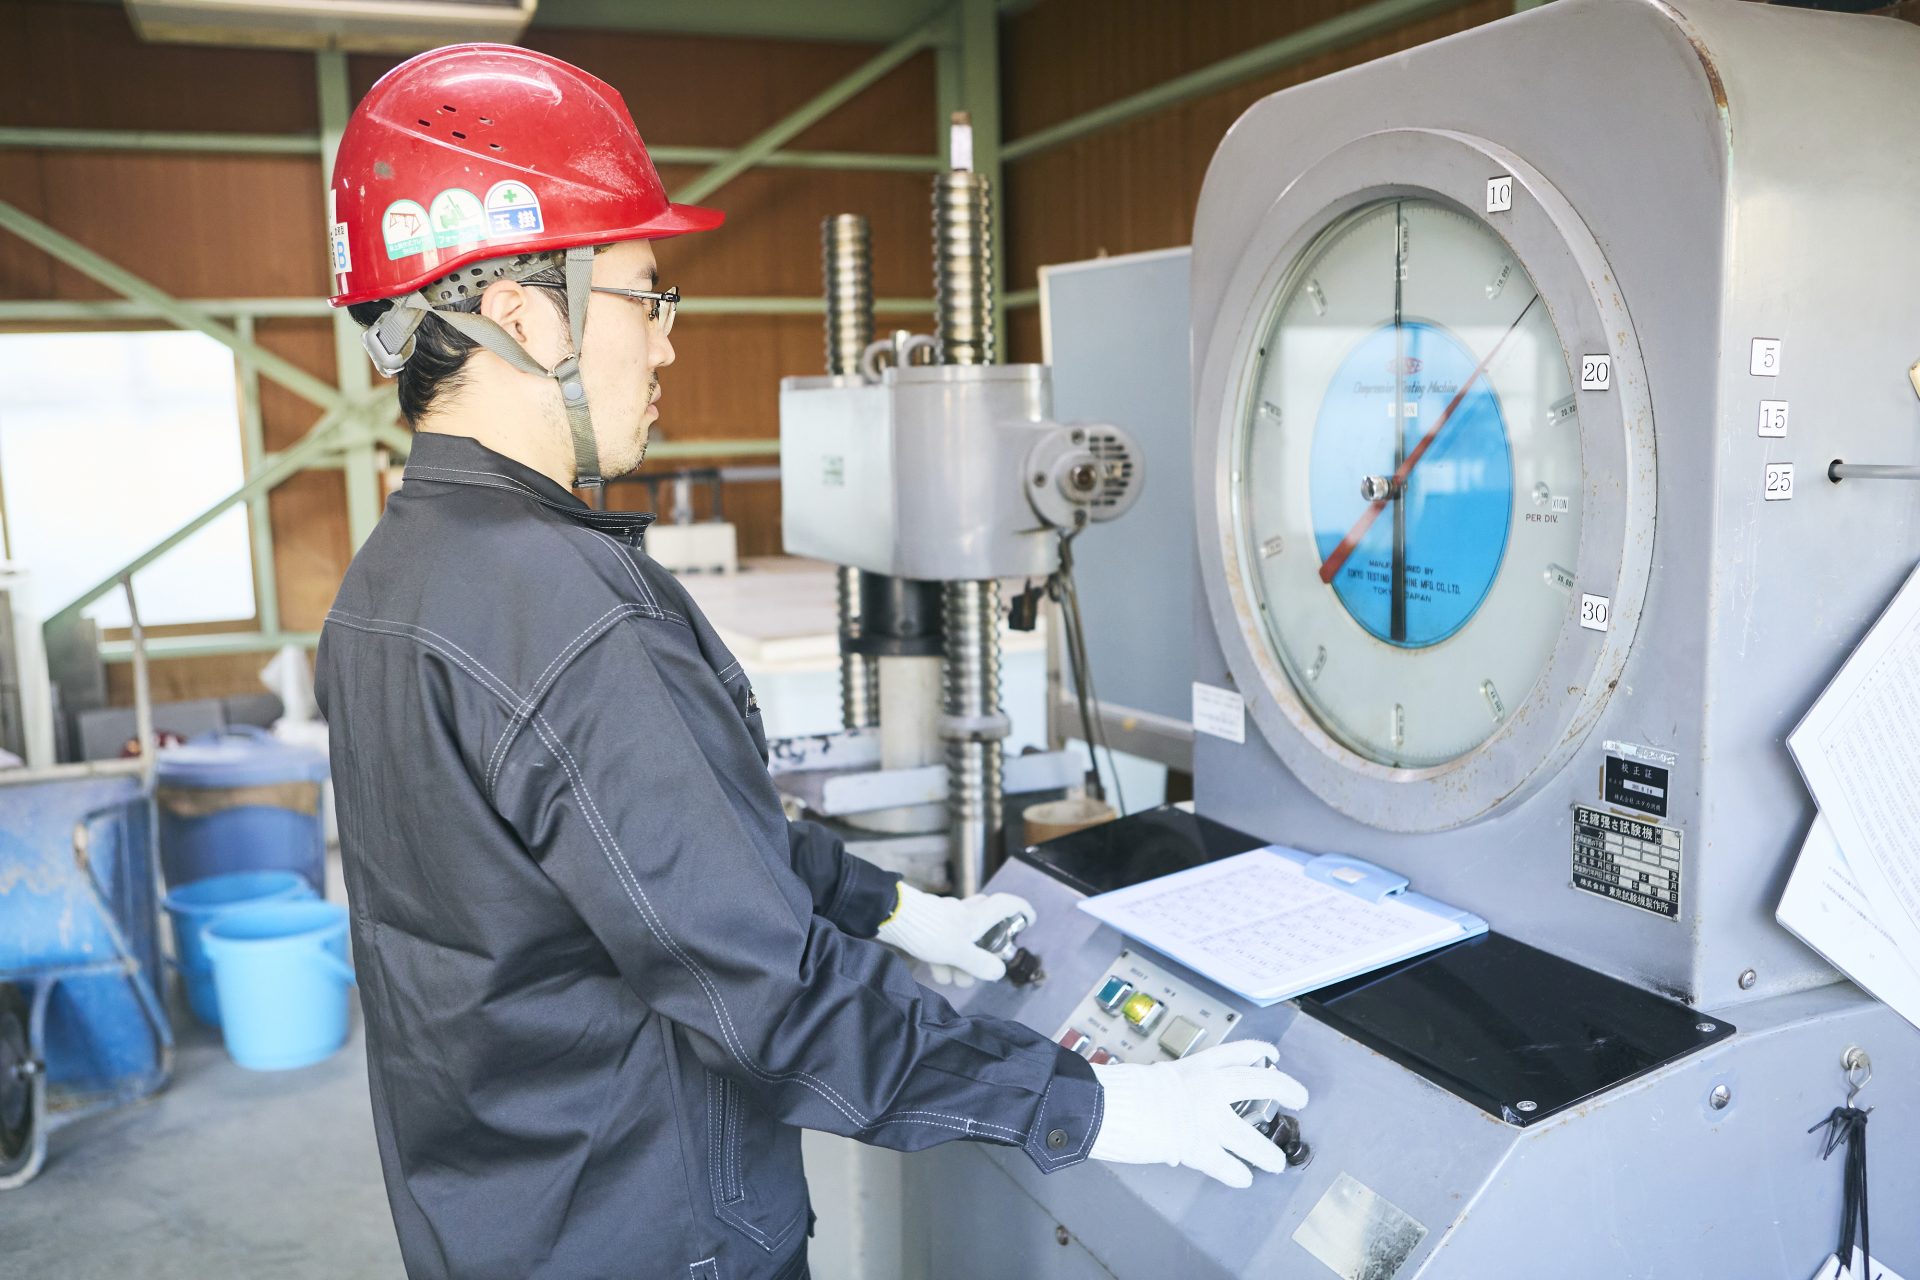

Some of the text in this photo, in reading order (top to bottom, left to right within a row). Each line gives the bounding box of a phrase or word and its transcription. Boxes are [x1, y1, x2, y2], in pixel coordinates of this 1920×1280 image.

[1491, 184, 1510, 205] 10
[1764, 347, 1775, 368] 5
[1584, 362, 1608, 382] 20
[1427, 380, 1458, 393] Machine
[1762, 408, 1785, 428] 15
[1768, 471, 1791, 491] 25
[1525, 513, 1559, 524] PER DIV.
[1424, 566, 1434, 576] BY
[1583, 601, 1607, 623] 30
[1578, 809, 1653, 841] 圧縮強さ試験機
